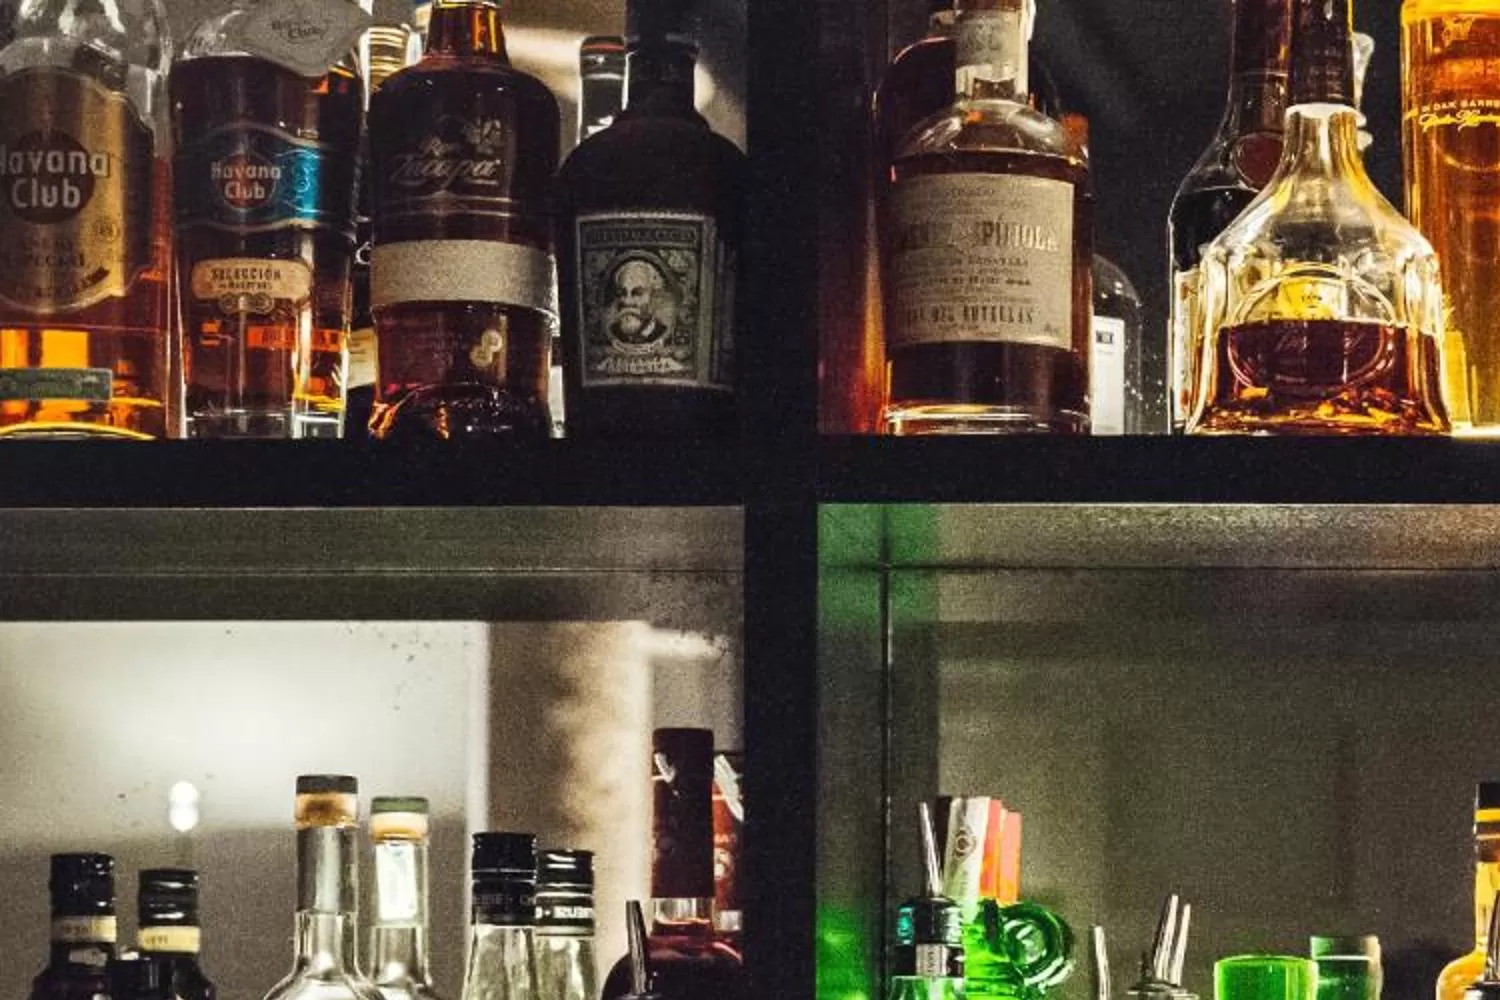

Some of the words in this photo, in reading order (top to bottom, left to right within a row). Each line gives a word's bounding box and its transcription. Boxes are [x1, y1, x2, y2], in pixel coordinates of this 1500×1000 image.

[211, 159, 281, 181] Havana
[12, 177, 81, 208] Club
[224, 180, 266, 200] Club
